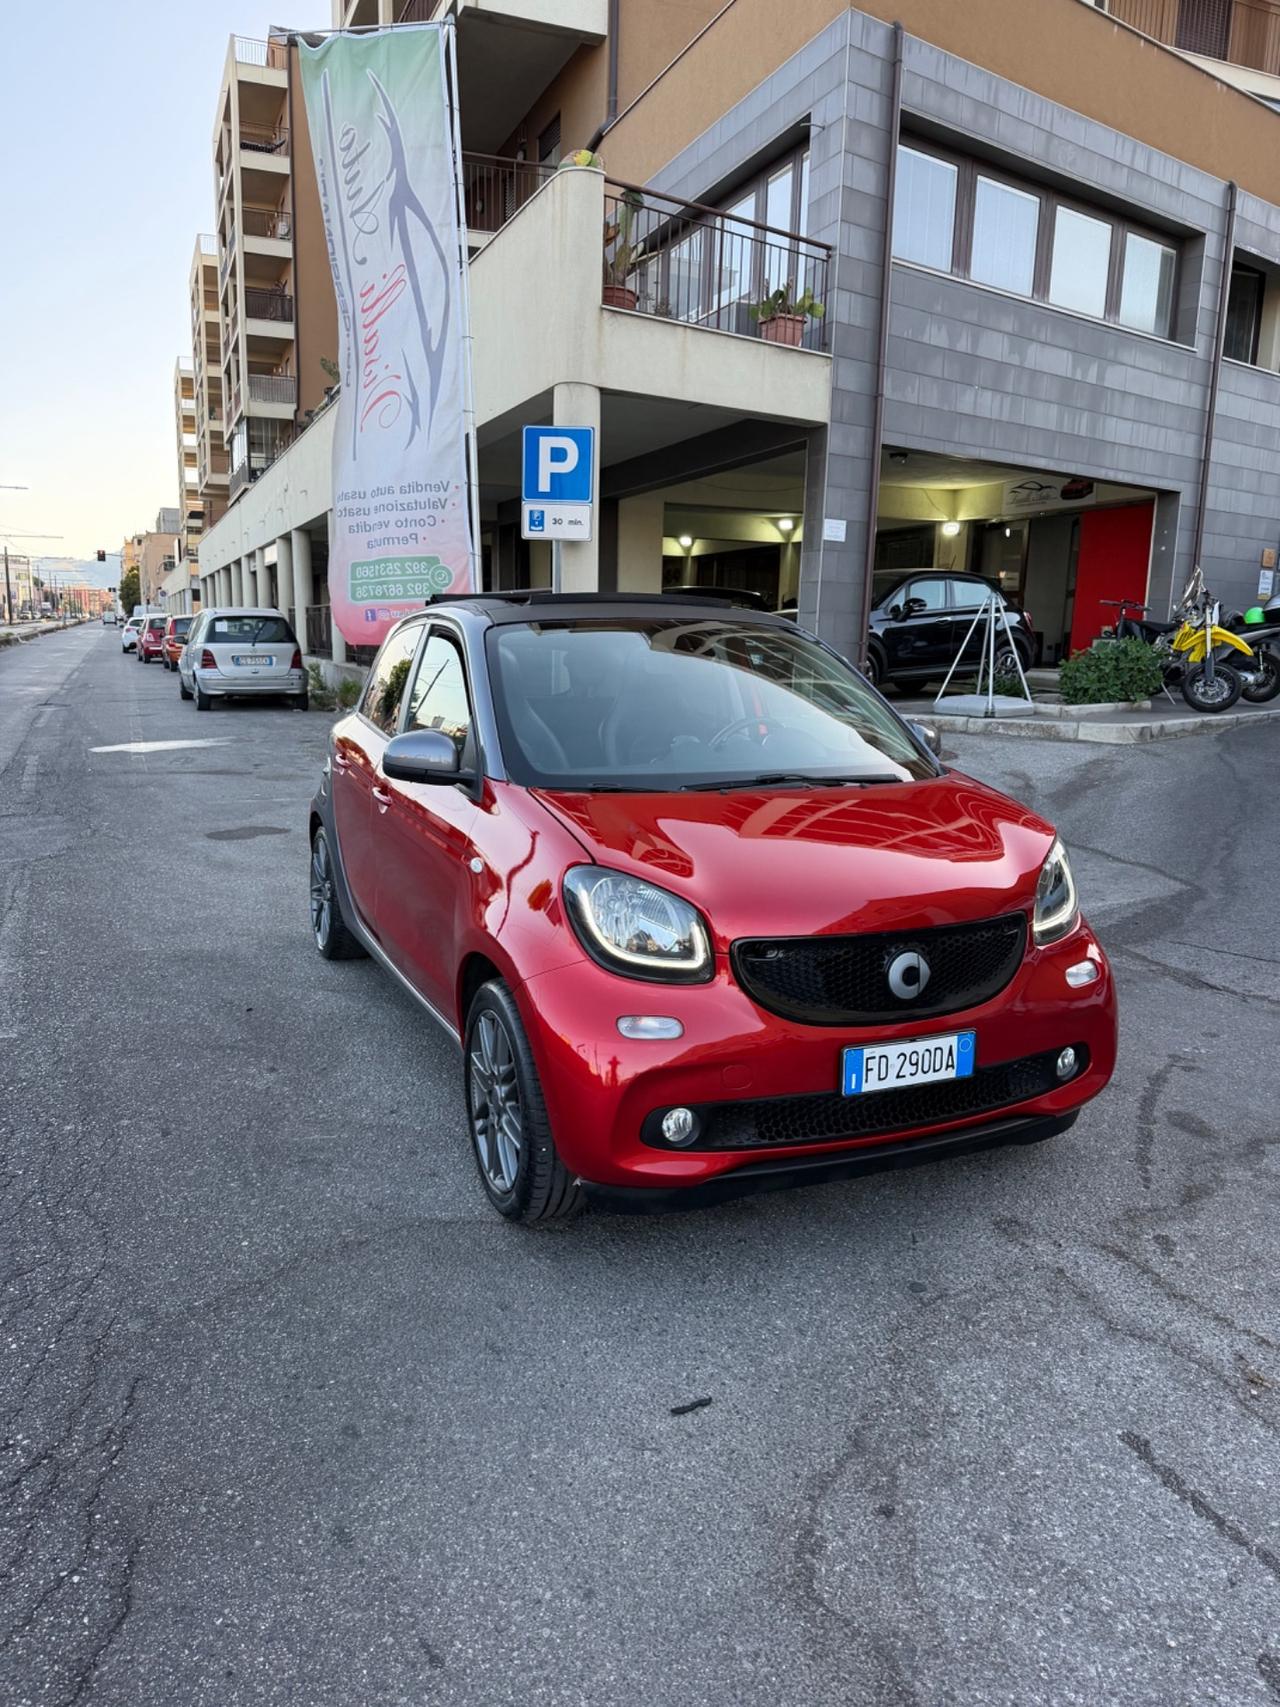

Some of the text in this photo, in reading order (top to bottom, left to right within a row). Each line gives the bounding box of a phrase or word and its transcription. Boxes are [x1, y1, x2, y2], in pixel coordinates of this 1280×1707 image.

[538, 436, 579, 492] P
[865, 1044, 956, 1084] FD 290DA
